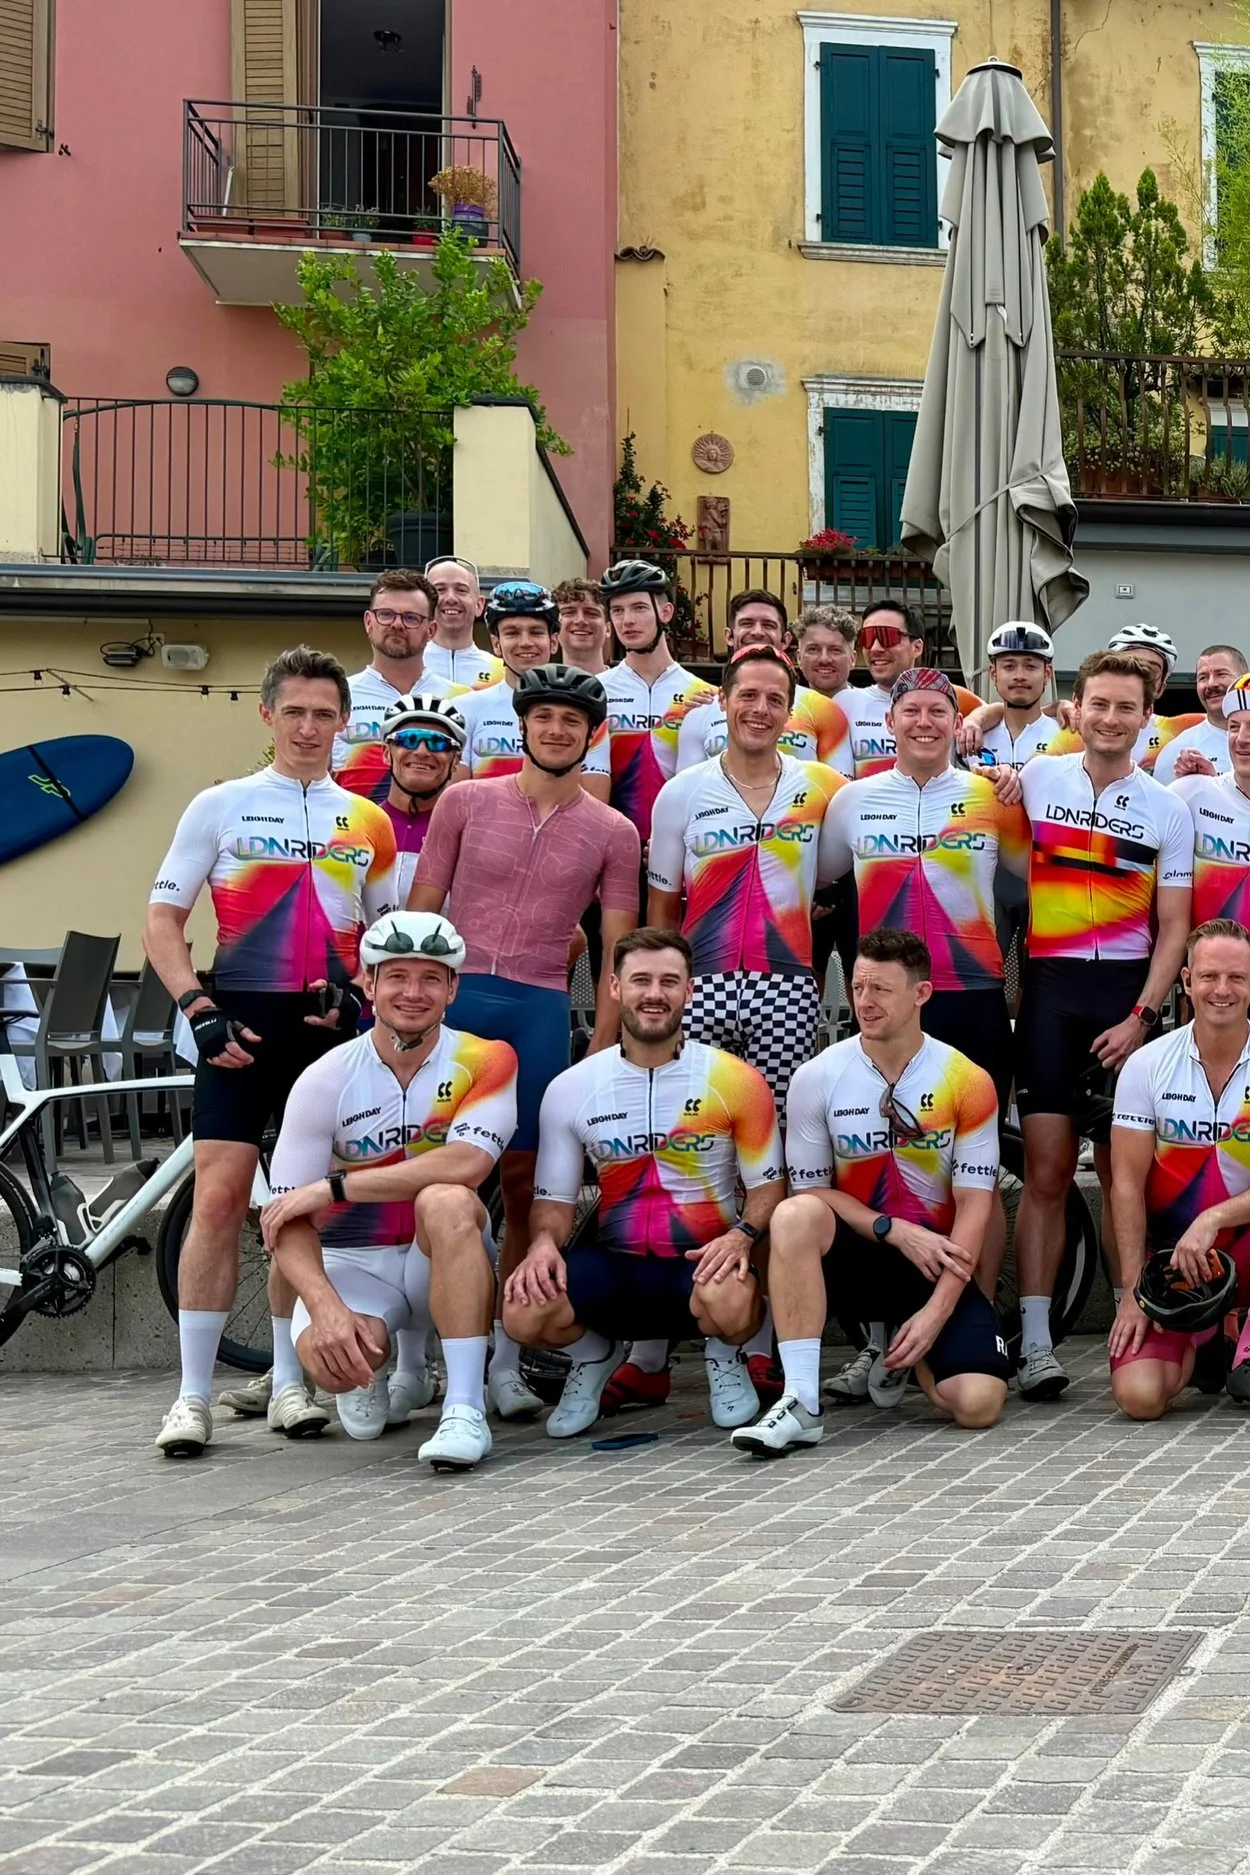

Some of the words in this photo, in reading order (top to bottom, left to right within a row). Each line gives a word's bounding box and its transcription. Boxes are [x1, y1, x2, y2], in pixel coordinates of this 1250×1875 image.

[1045, 804, 1145, 840] LDNRIDERS
[833, 1109, 854, 1117] LEIGH
[342, 1114, 365, 1128] LEIGH
[587, 1115, 611, 1127] LEIGH
